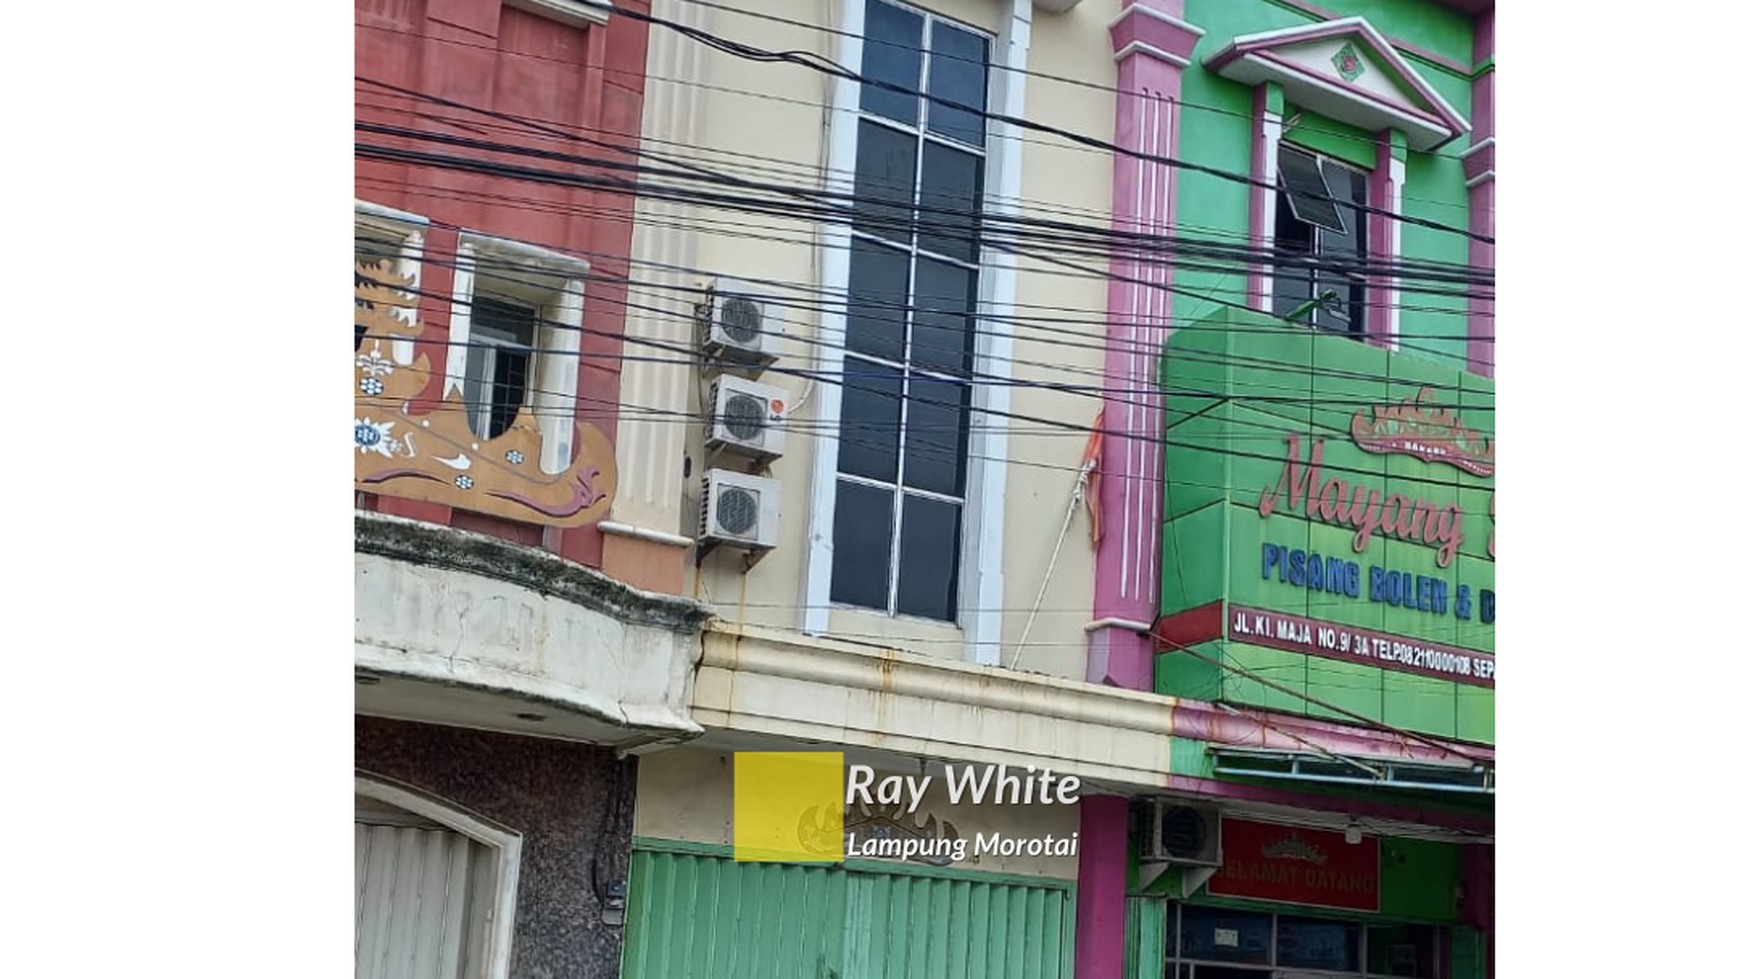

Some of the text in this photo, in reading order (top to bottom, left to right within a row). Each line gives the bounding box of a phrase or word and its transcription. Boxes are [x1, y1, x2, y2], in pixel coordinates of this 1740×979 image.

[1259, 433, 1465, 569] Mayang
[1261, 542, 1360, 598] PISANG
[1369, 565, 1448, 615] BOLEN
[1454, 584, 1472, 620] &
[1276, 619, 1312, 645] MAJA
[1473, 658, 1495, 680] SEP
[1305, 868, 1375, 894] DATANG
